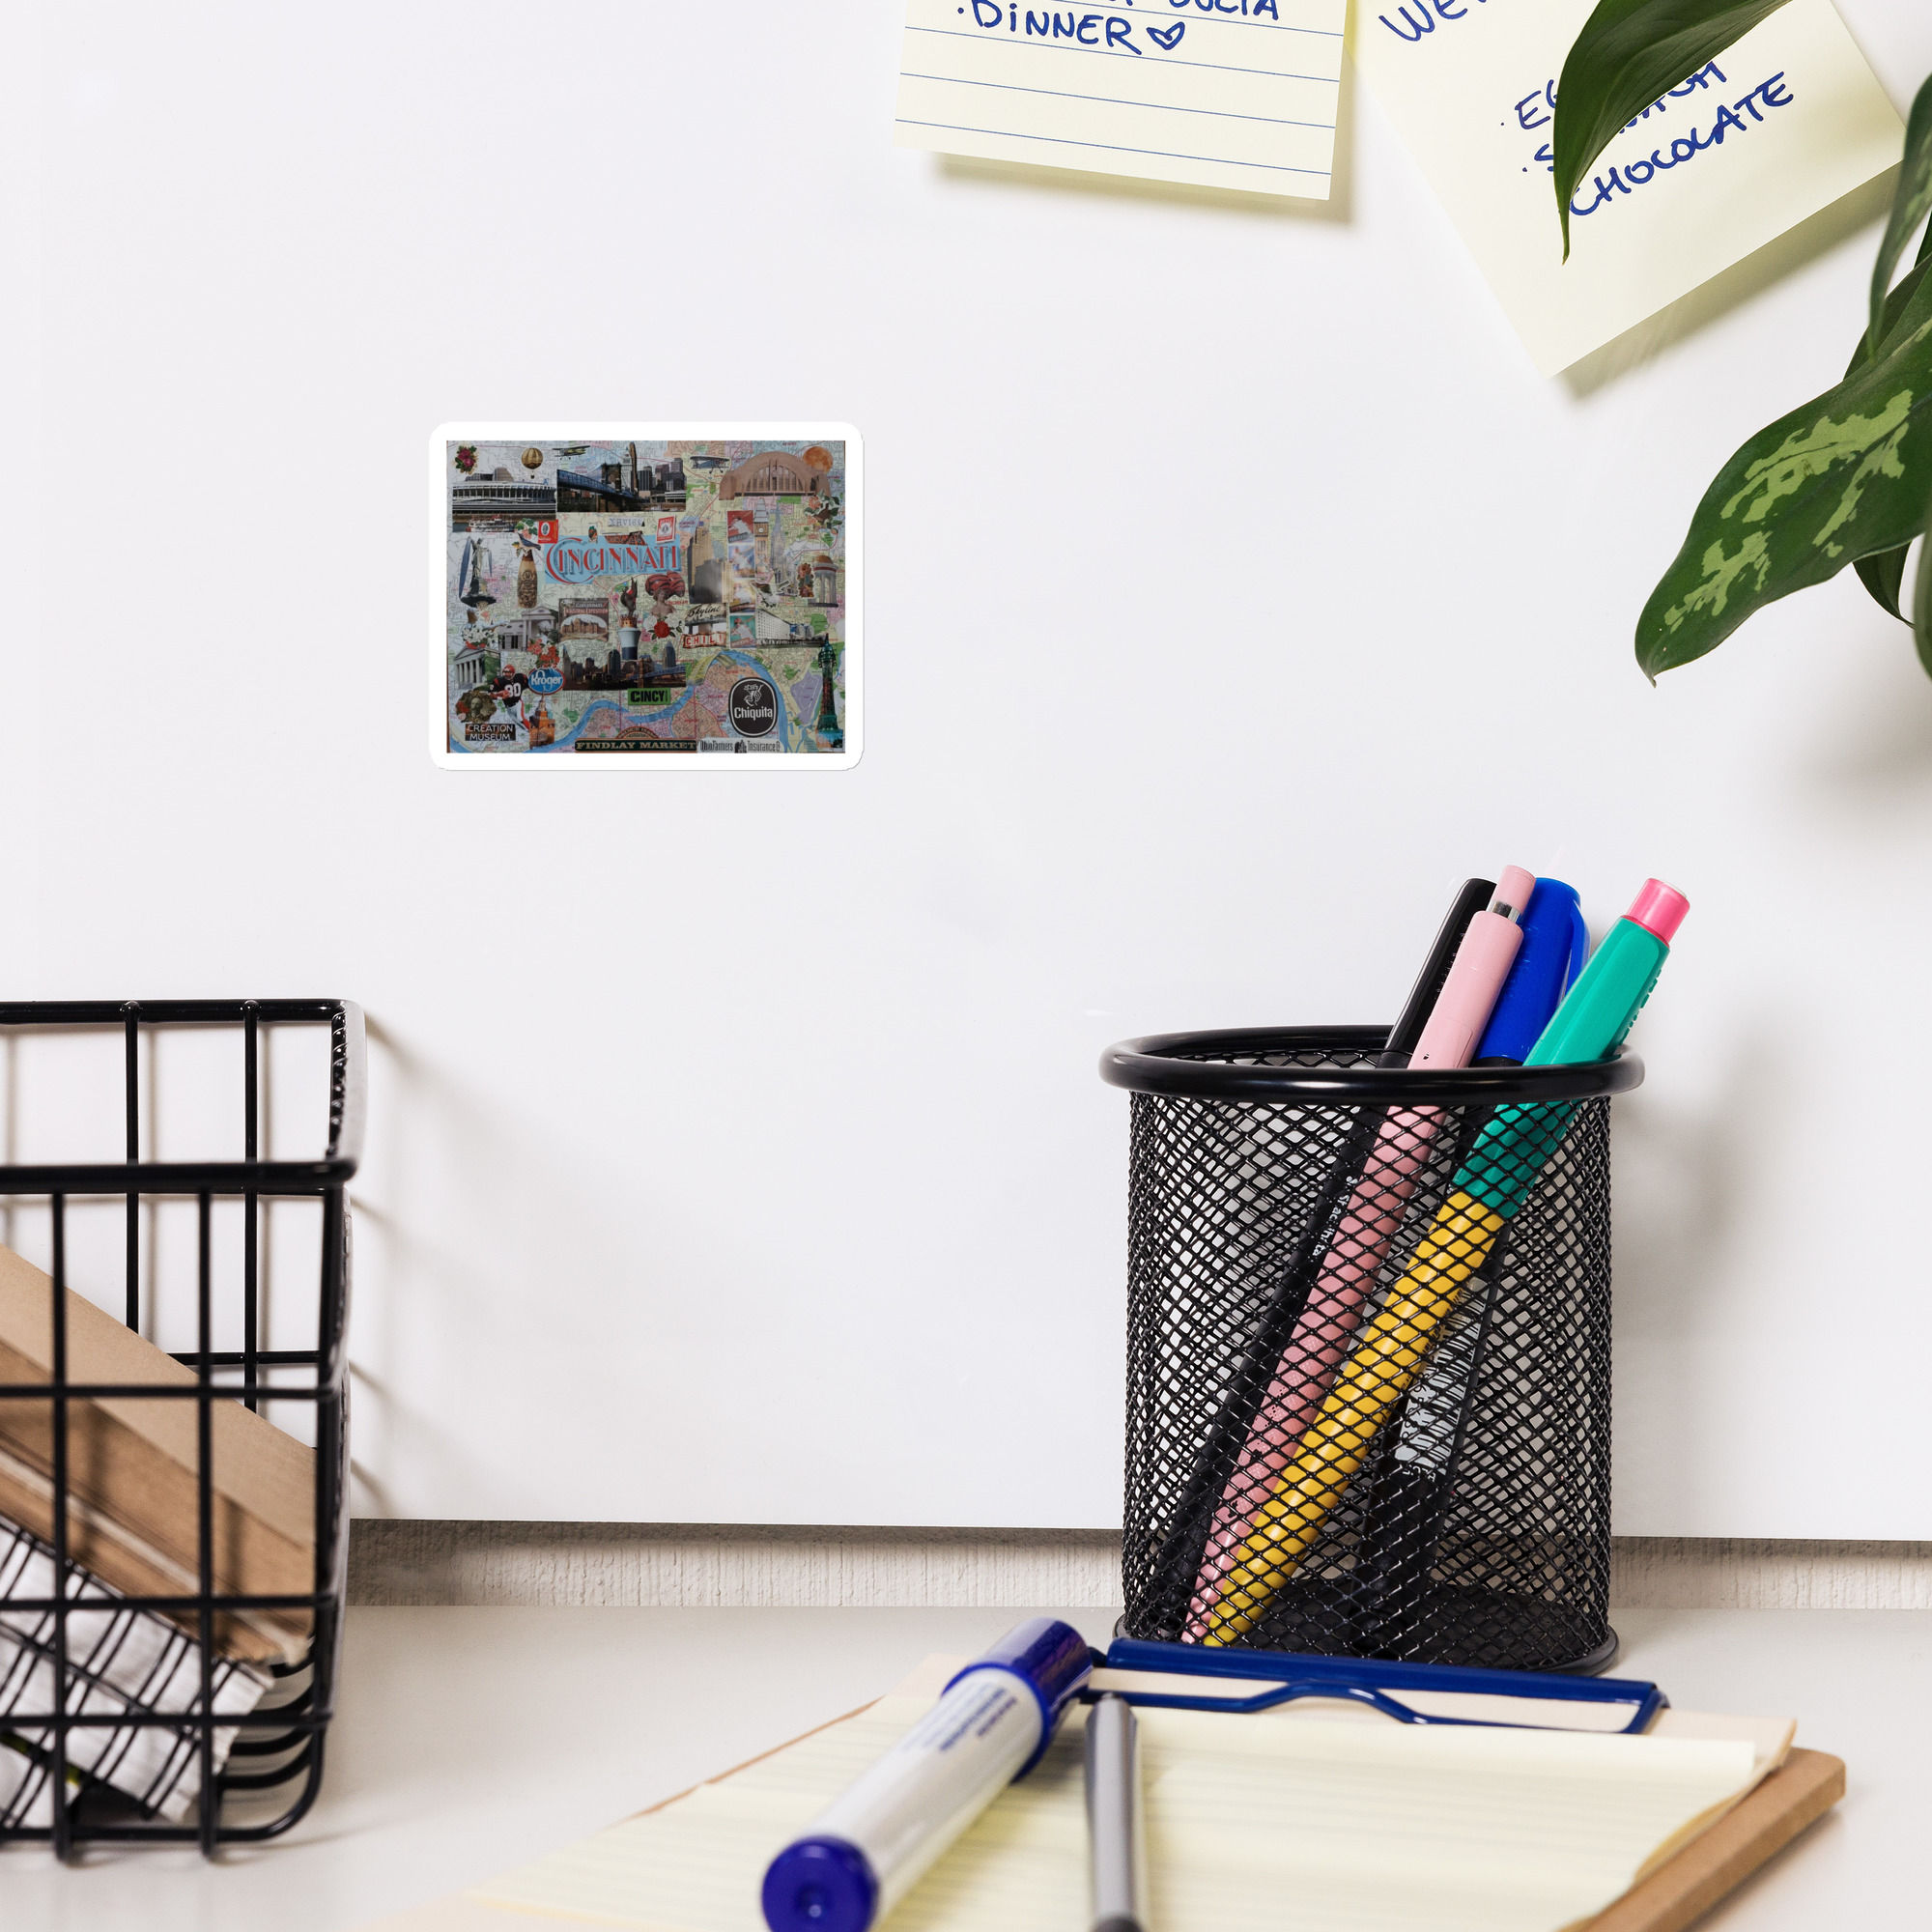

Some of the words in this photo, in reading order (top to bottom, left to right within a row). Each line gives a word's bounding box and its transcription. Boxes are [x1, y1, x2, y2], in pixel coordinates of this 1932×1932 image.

[1569, 71, 1795, 216] CHOCOLATE
[546, 536, 680, 585] CINCINNATI
[530, 669, 563, 693] Kroger
[734, 705, 774, 722] Chiquita
[468, 724, 514, 733] CREATION
[576, 741, 636, 750] FINDLAY
[639, 741, 696, 750] MARKET
